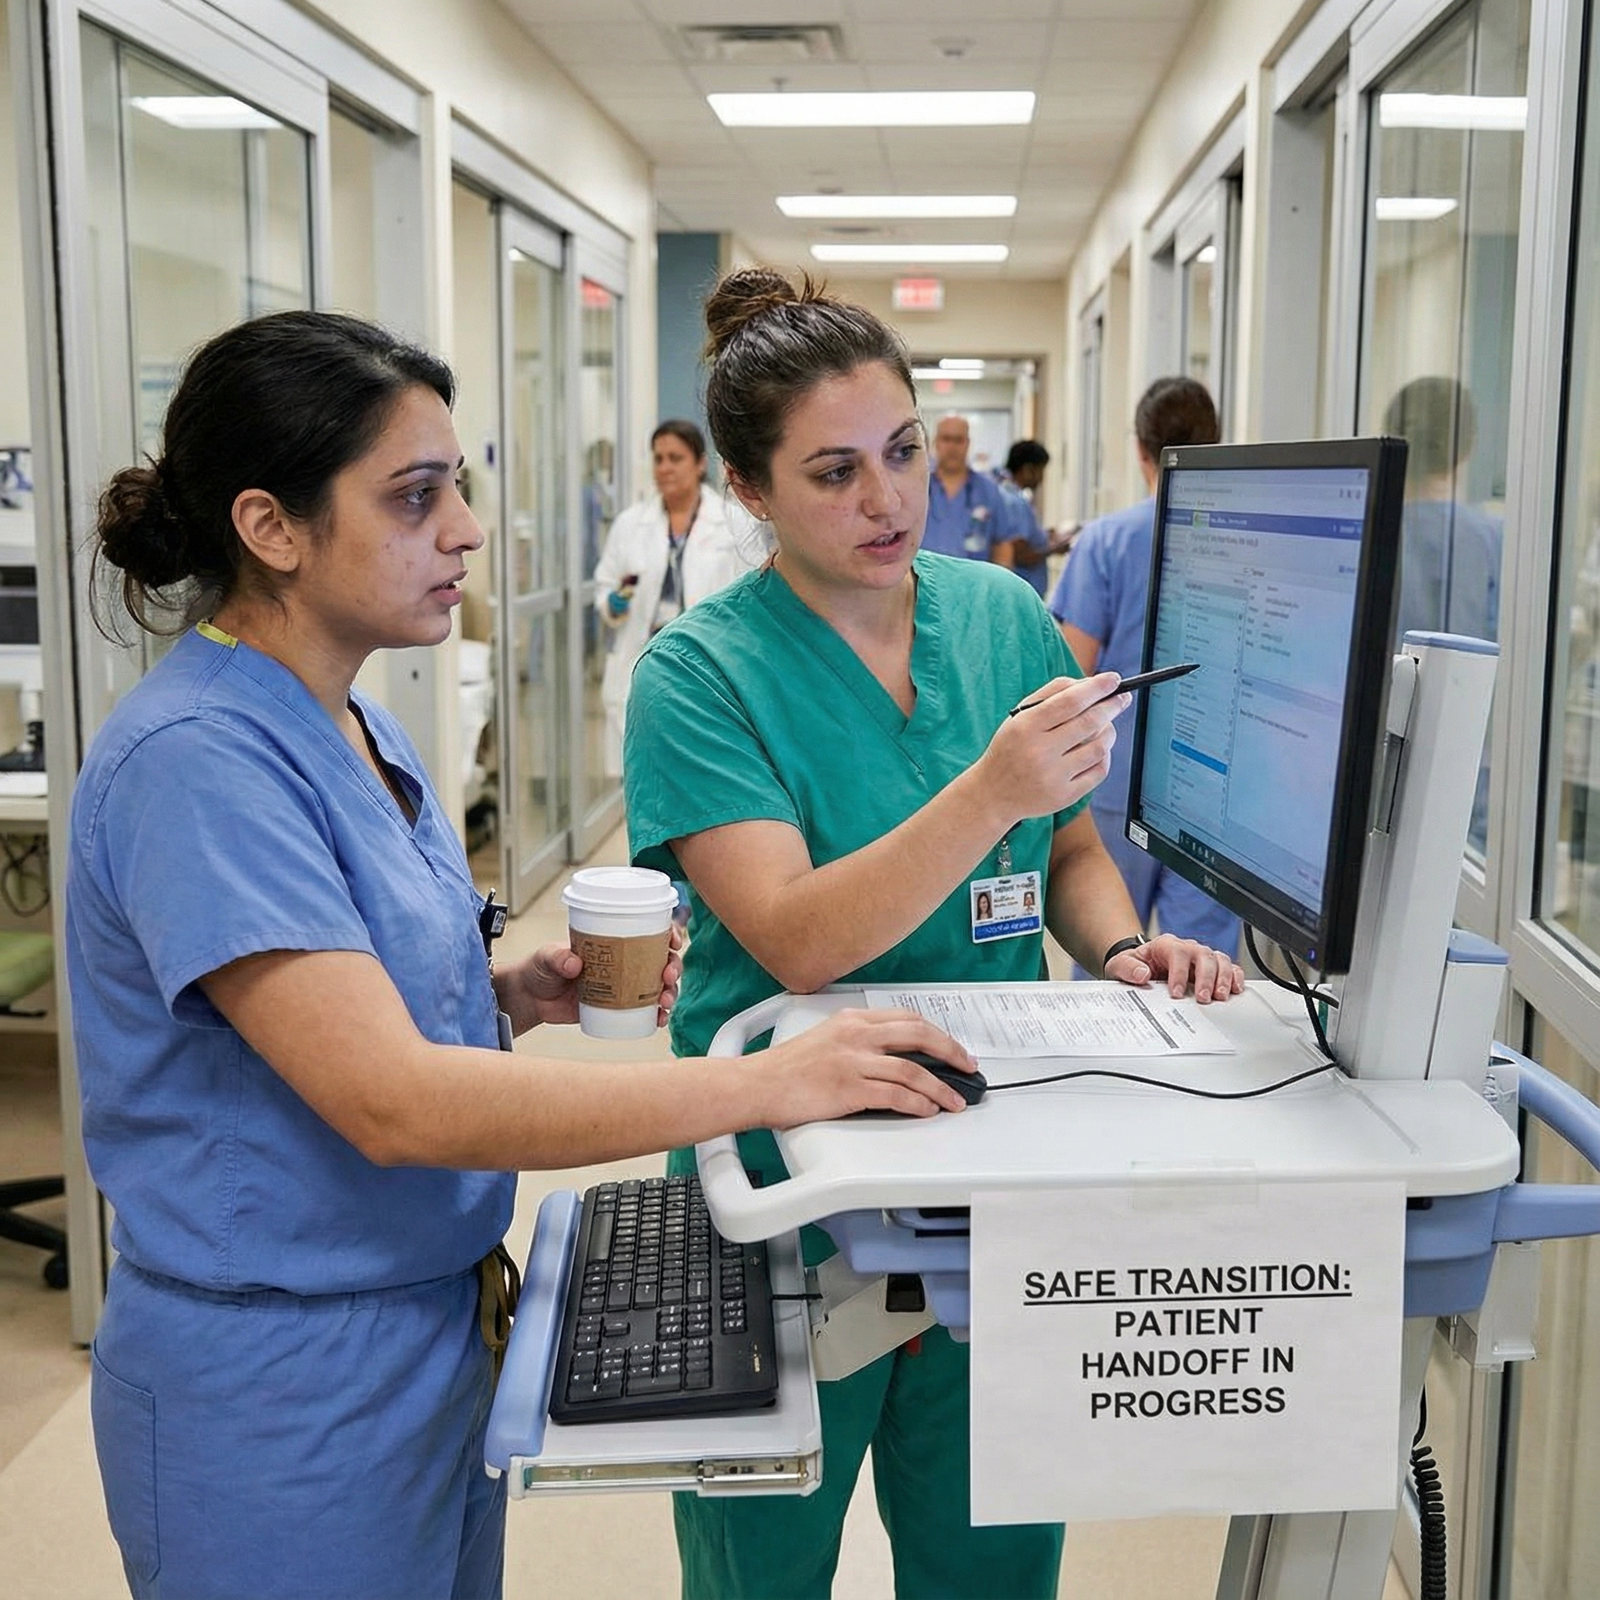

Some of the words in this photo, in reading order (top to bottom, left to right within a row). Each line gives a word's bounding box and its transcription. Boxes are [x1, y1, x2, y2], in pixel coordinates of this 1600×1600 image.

[1024, 1269, 1117, 1299] SAFE
[1127, 1263, 1352, 1296] TRANSITION:
[1115, 1307, 1264, 1338] PATIENT
[1082, 1347, 1250, 1379] HANDOFF
[1262, 1346, 1295, 1374] IN
[1091, 1386, 1287, 1419] PROGRESS
